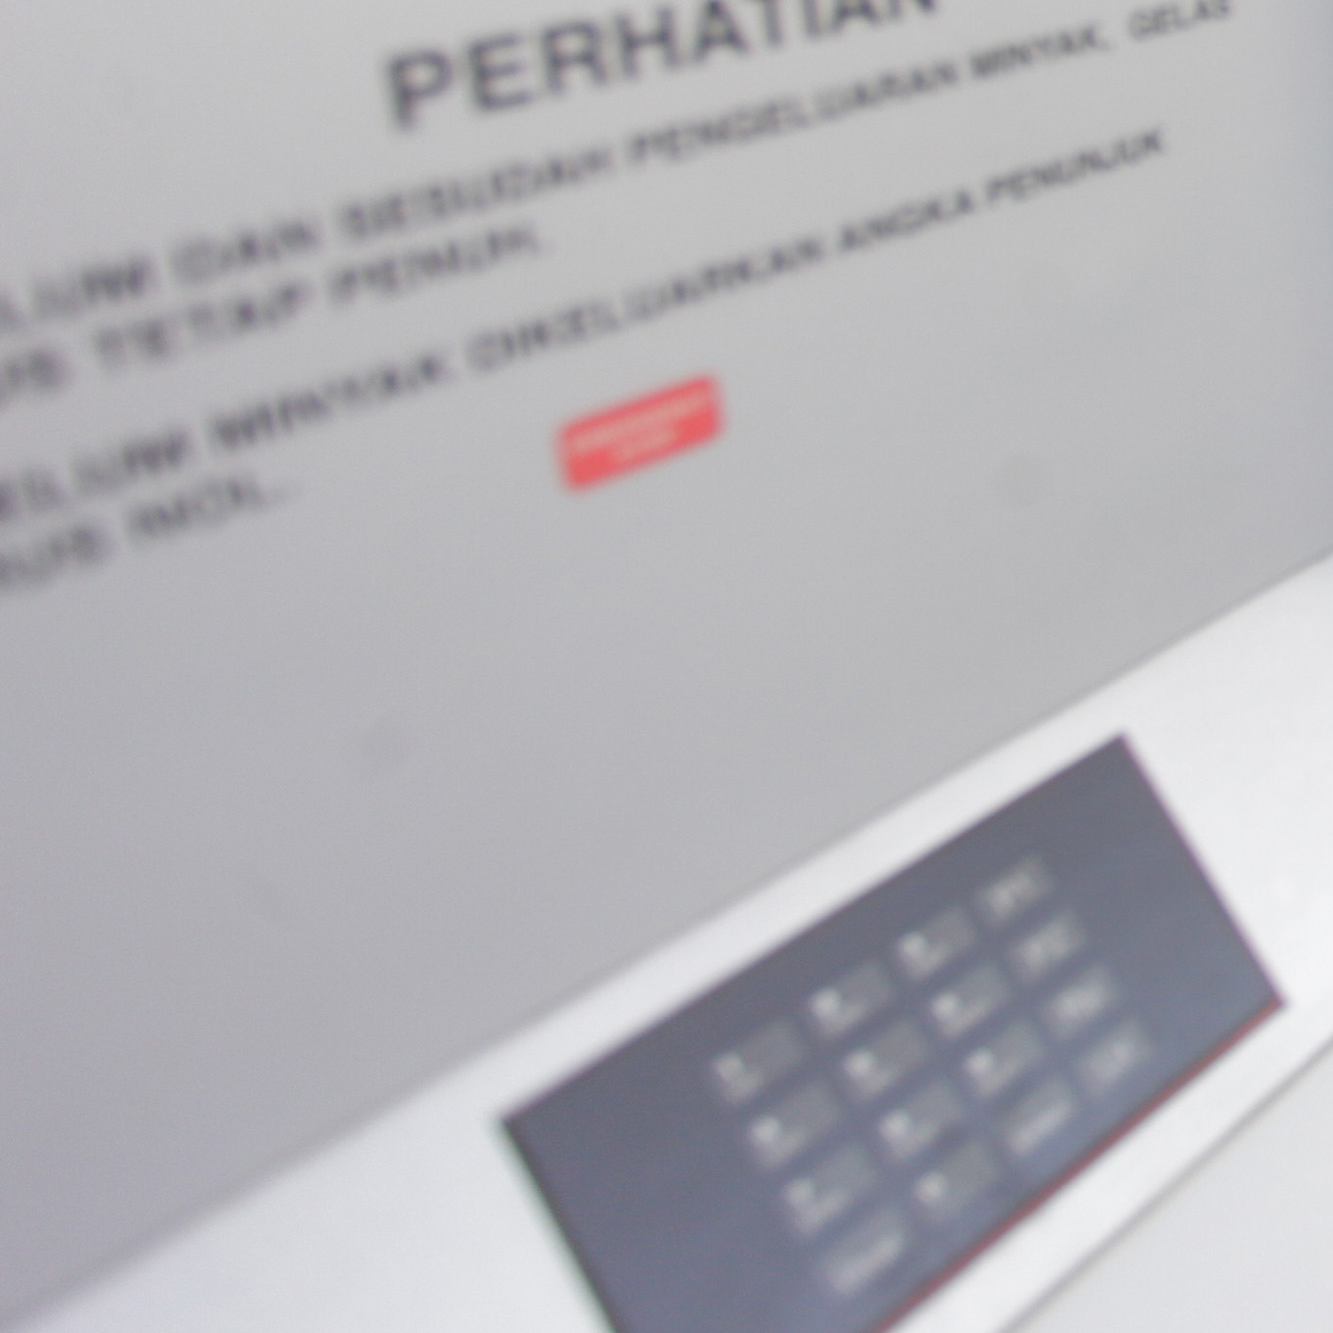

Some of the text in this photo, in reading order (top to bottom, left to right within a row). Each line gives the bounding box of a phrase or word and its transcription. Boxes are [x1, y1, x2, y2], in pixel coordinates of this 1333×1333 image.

[627, 56, 960, 166] PENGELUARAN
[465, 232, 826, 376] DIKELUARKAN
[838, 187, 977, 255] ANGKA
[983, 124, 1166, 202] PENUNJUK
